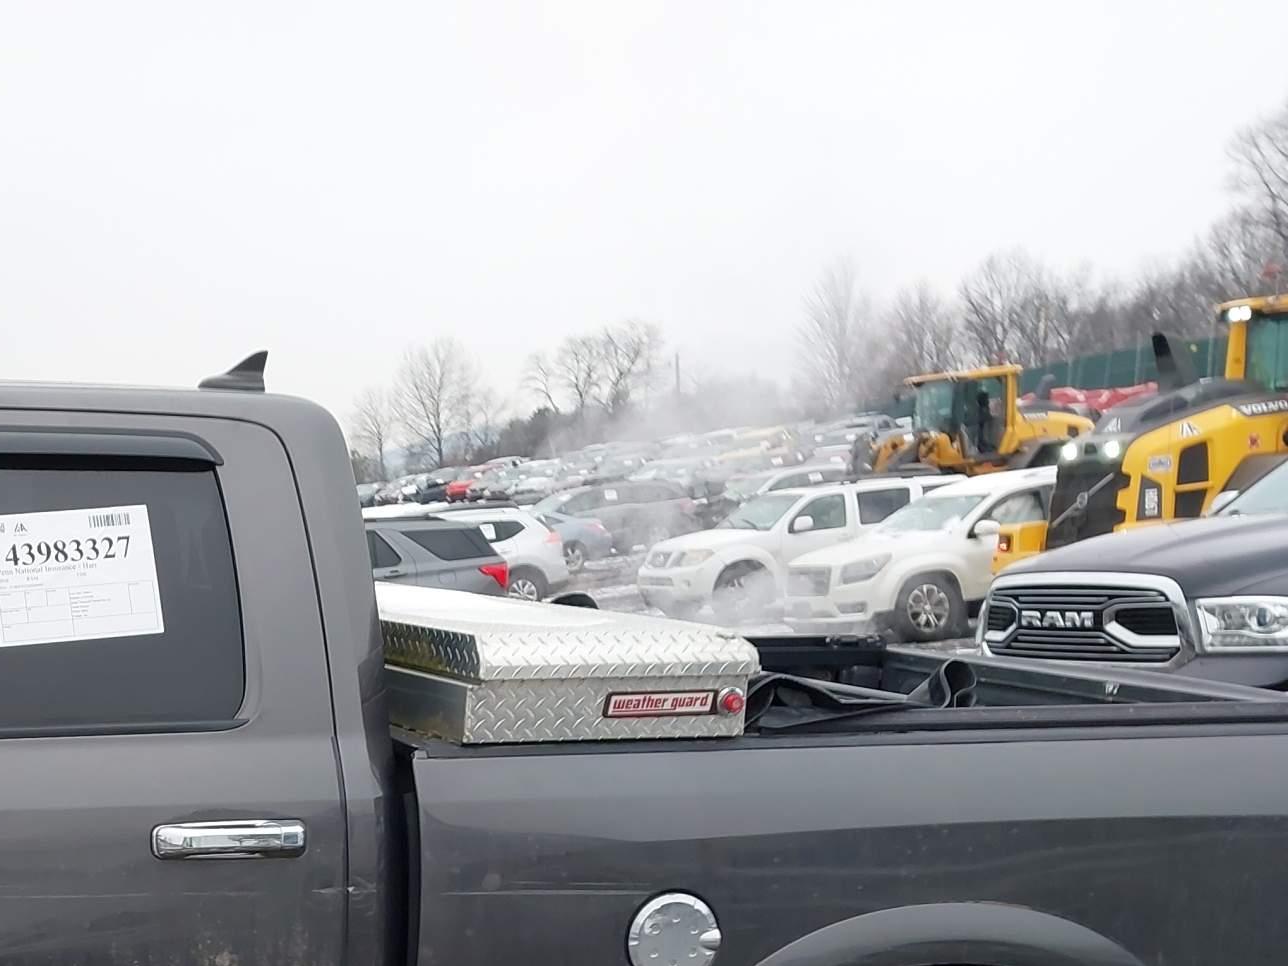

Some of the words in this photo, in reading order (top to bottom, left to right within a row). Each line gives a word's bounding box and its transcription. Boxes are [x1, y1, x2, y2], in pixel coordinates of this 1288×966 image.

[5, 536, 130, 566] 43983327
[1021, 610, 1094, 628] RAM
[613, 695, 668, 710] weather
[670, 694, 710, 710] guard
